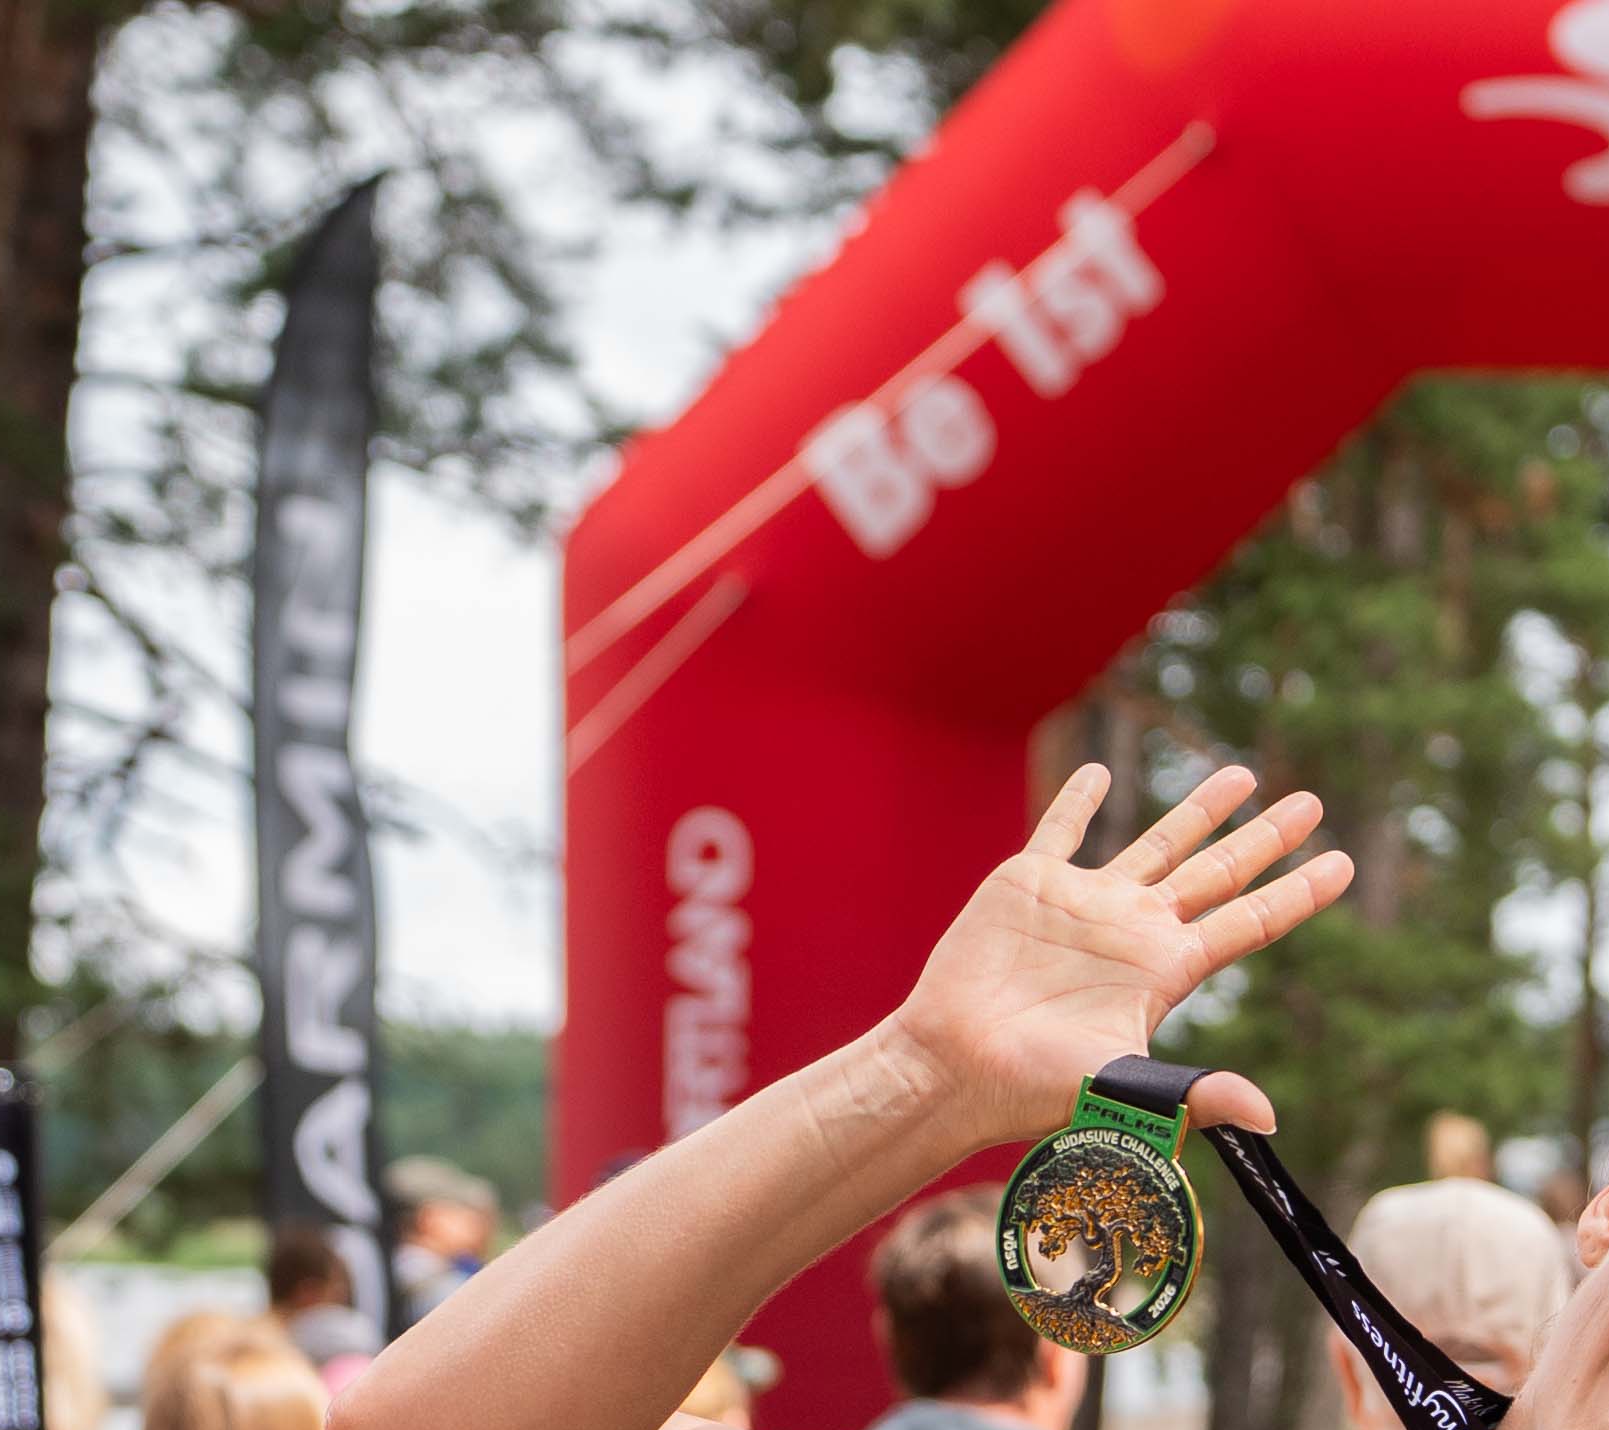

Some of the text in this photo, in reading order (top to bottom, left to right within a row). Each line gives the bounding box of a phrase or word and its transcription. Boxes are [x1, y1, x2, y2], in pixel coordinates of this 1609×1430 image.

[797, 186, 1166, 560] Be 1st
[1083, 1102, 1172, 1138] PALMS
[1120, 1134, 1181, 1192] CHALLENGE
[1147, 1283, 1178, 1319] 2026
